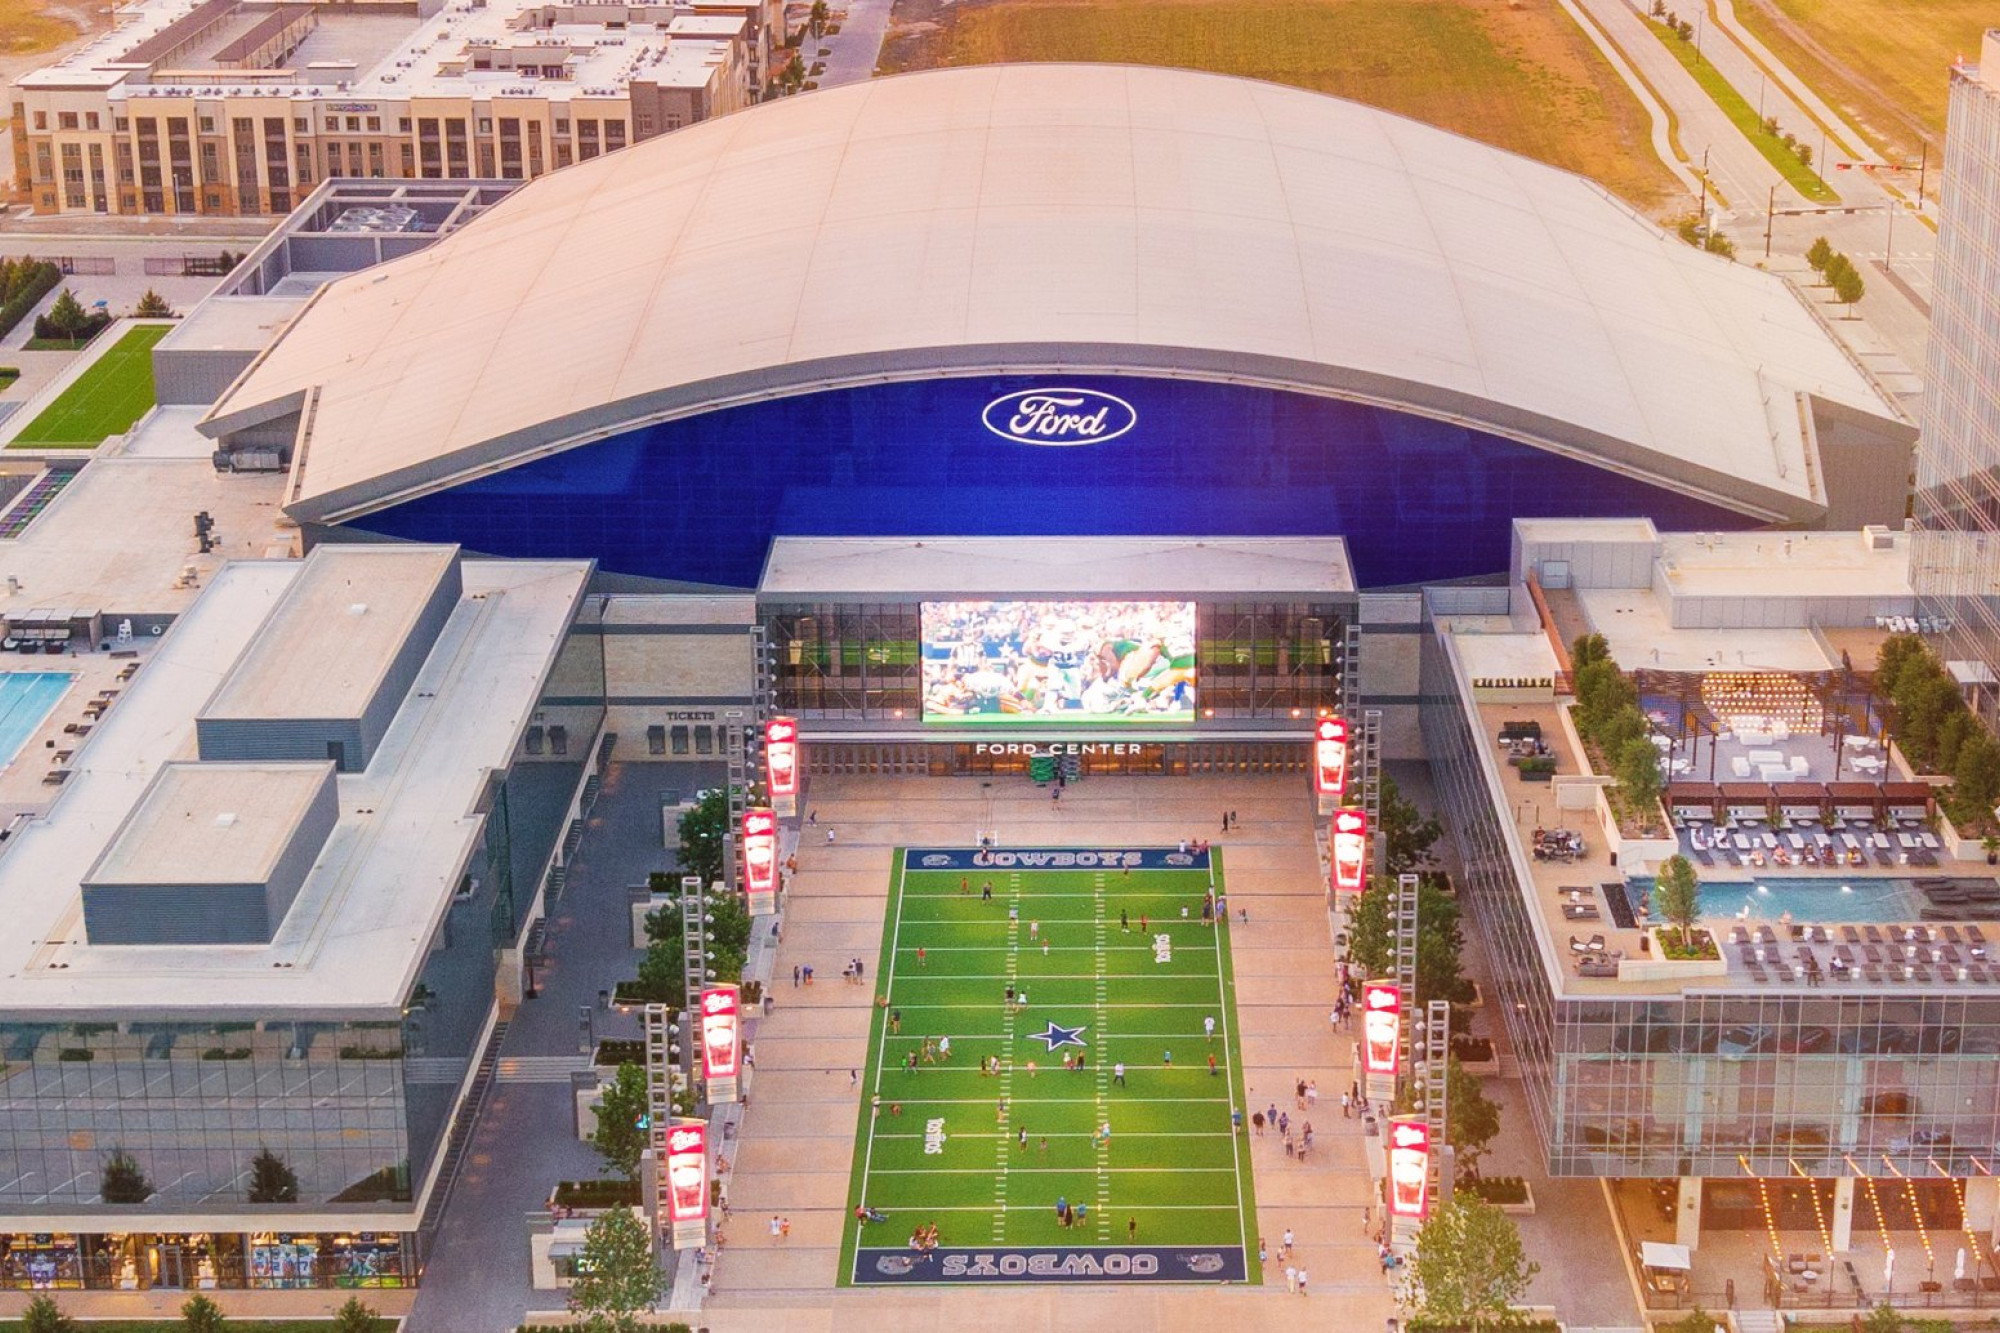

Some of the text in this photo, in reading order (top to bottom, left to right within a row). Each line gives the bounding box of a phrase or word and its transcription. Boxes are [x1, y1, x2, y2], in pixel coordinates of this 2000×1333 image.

[1009, 396, 1109, 435] Ford
[666, 711, 715, 721] TICKETS
[976, 743, 1142, 755] FORD CENTER
[973, 852, 1142, 866] COWBOYS
[942, 1254, 1158, 1275] COWBOYS
